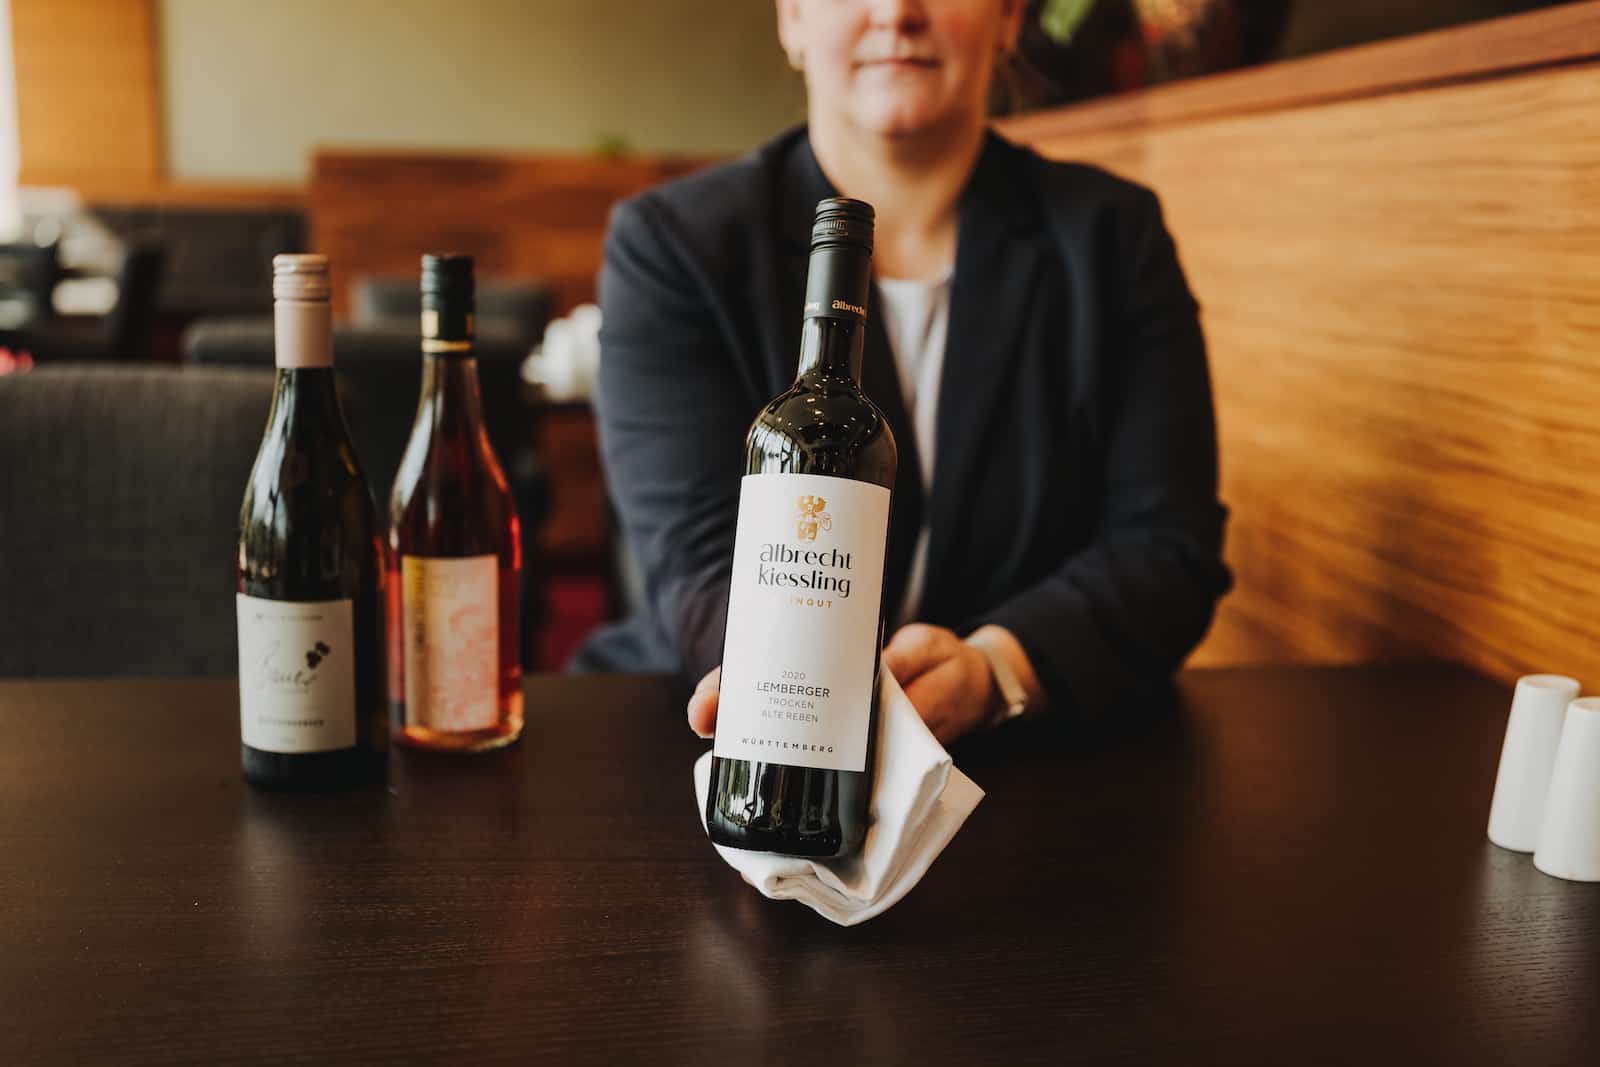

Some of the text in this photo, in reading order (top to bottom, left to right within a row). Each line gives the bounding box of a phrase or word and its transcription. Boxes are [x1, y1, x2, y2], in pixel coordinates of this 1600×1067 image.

[759, 543, 853, 570] albrecht
[758, 563, 852, 599] kiessling
[783, 597, 834, 609] INGUT
[781, 670, 807, 681] 2020
[756, 681, 831, 698] LEMBERGER
[768, 697, 815, 709] TROCKEN
[761, 709, 819, 723] ALTE REBEN
[741, 737, 834, 753] WÜRTTEMBERG
